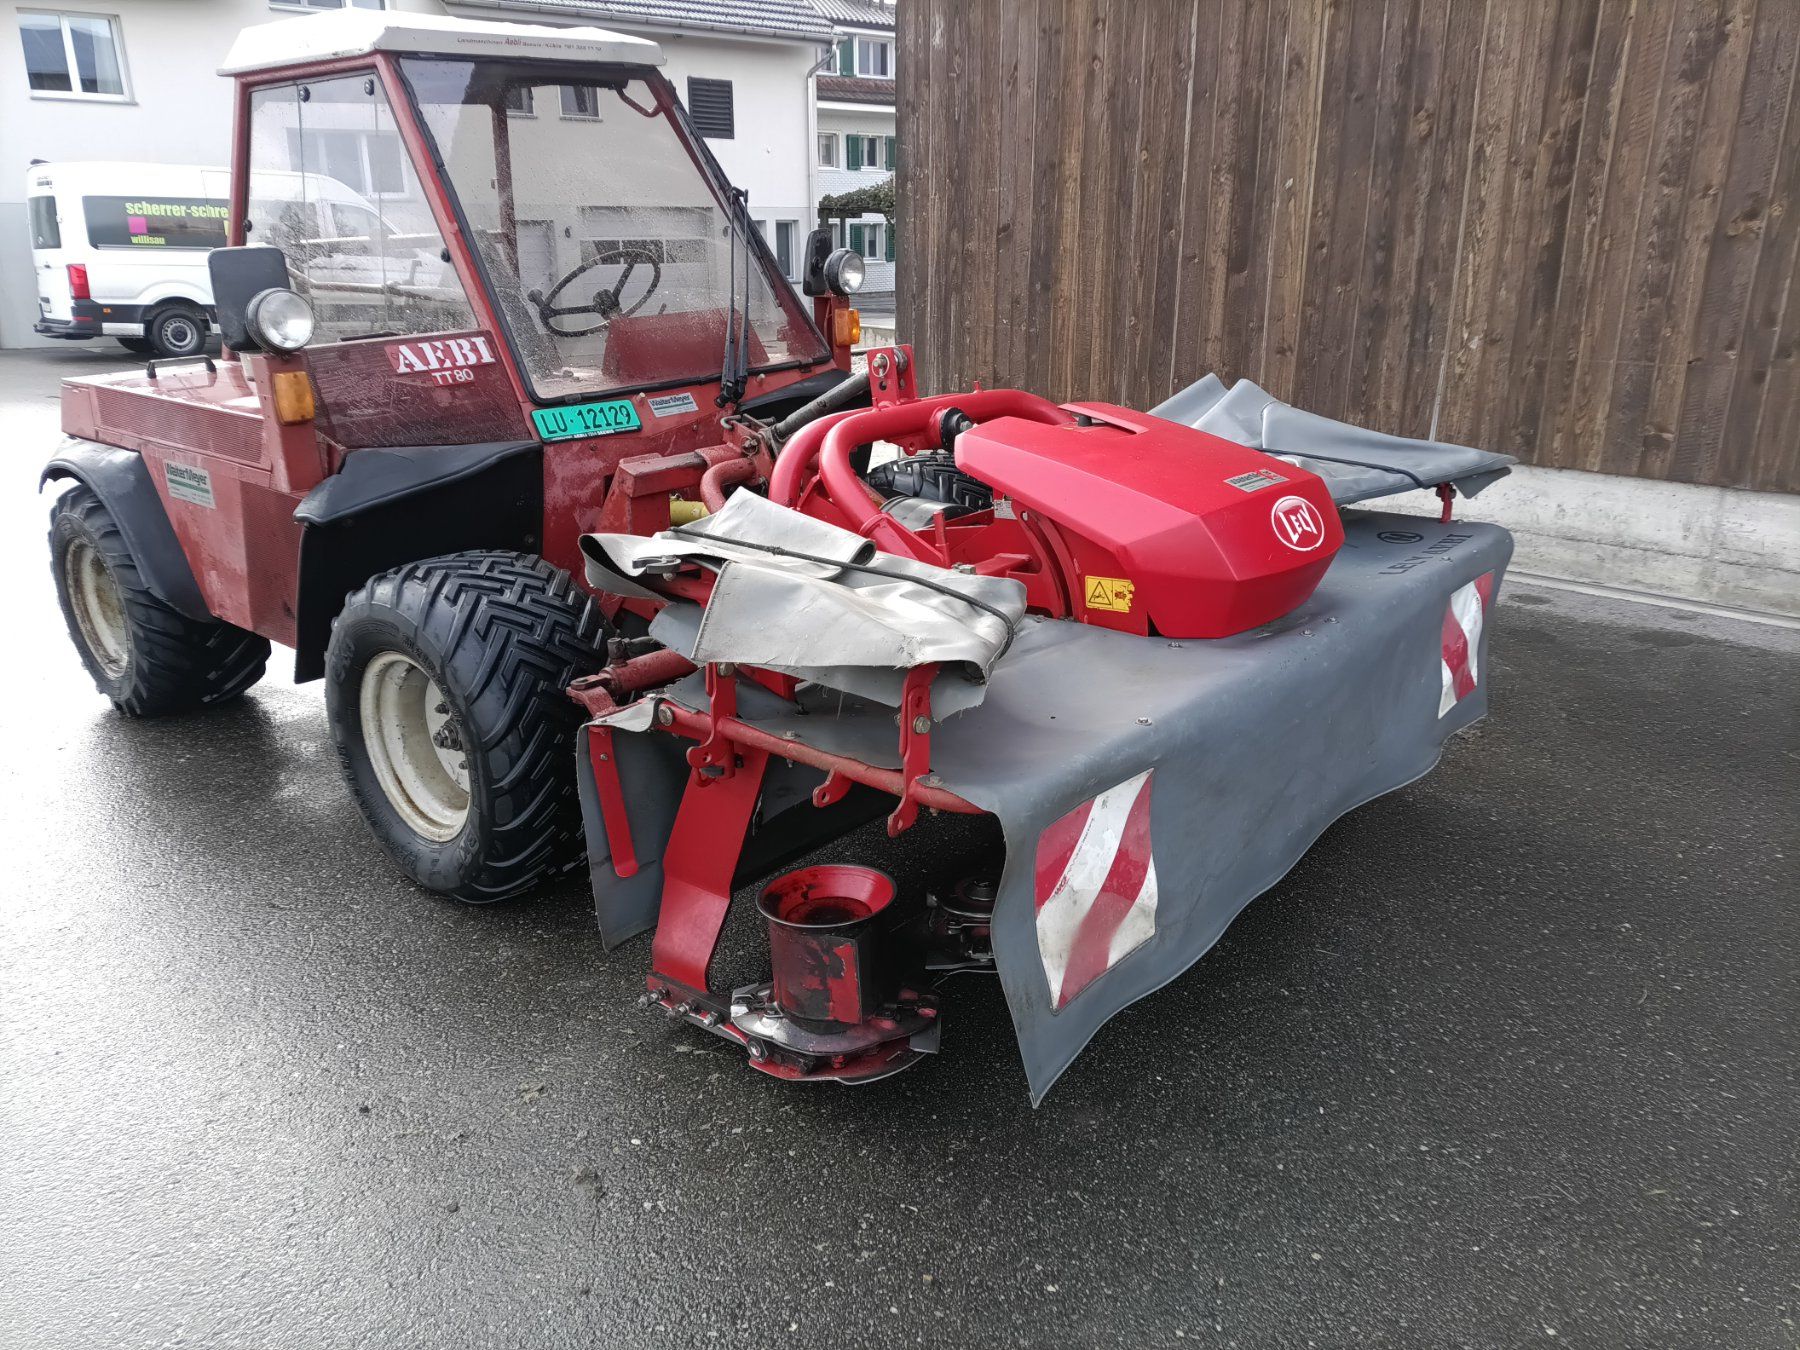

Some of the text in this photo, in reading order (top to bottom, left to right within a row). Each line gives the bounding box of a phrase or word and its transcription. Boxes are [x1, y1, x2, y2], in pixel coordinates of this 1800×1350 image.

[131, 235, 166, 245] willisau
[397, 336, 496, 374] AEBI
[1277, 502, 1319, 544] LELY
[1378, 556, 1433, 575] LELY
